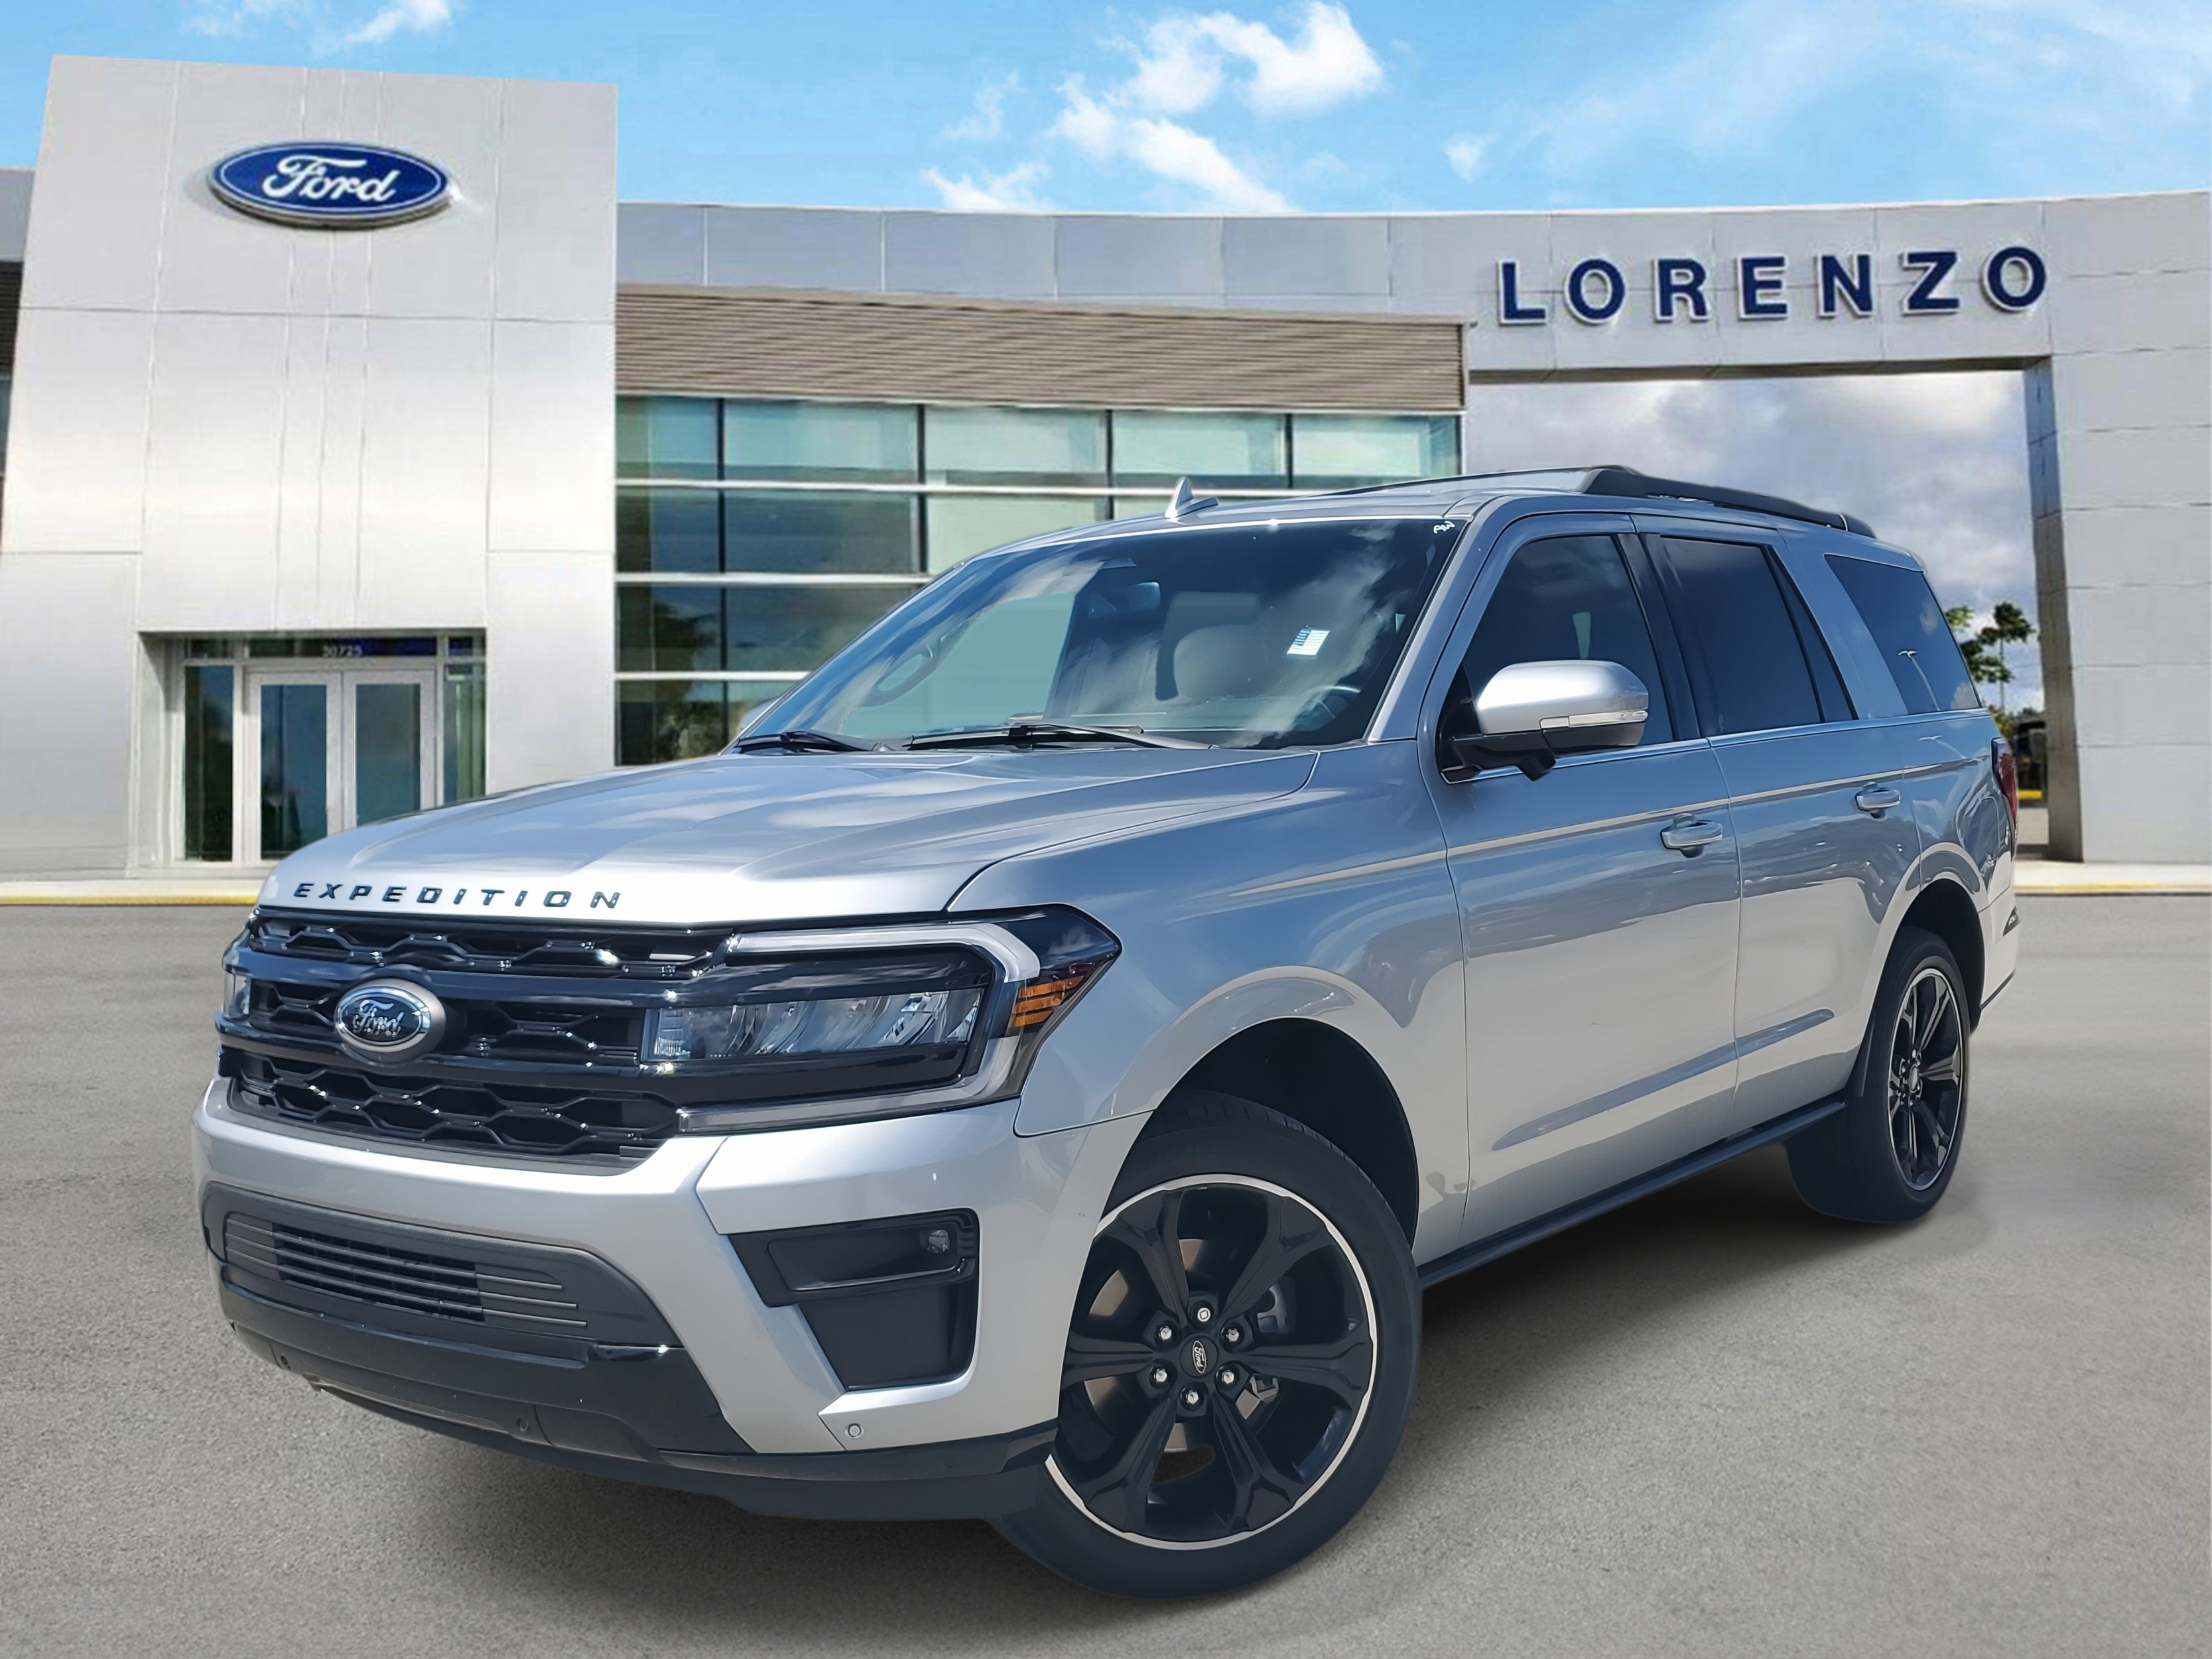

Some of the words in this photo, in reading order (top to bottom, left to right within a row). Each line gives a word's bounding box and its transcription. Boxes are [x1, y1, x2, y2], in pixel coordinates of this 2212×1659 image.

[261, 155, 400, 202] Ford
[1500, 245, 2047, 323] LORENZO
[293, 883, 621, 909] EXPEDITION
[352, 999, 405, 1037] Ford
